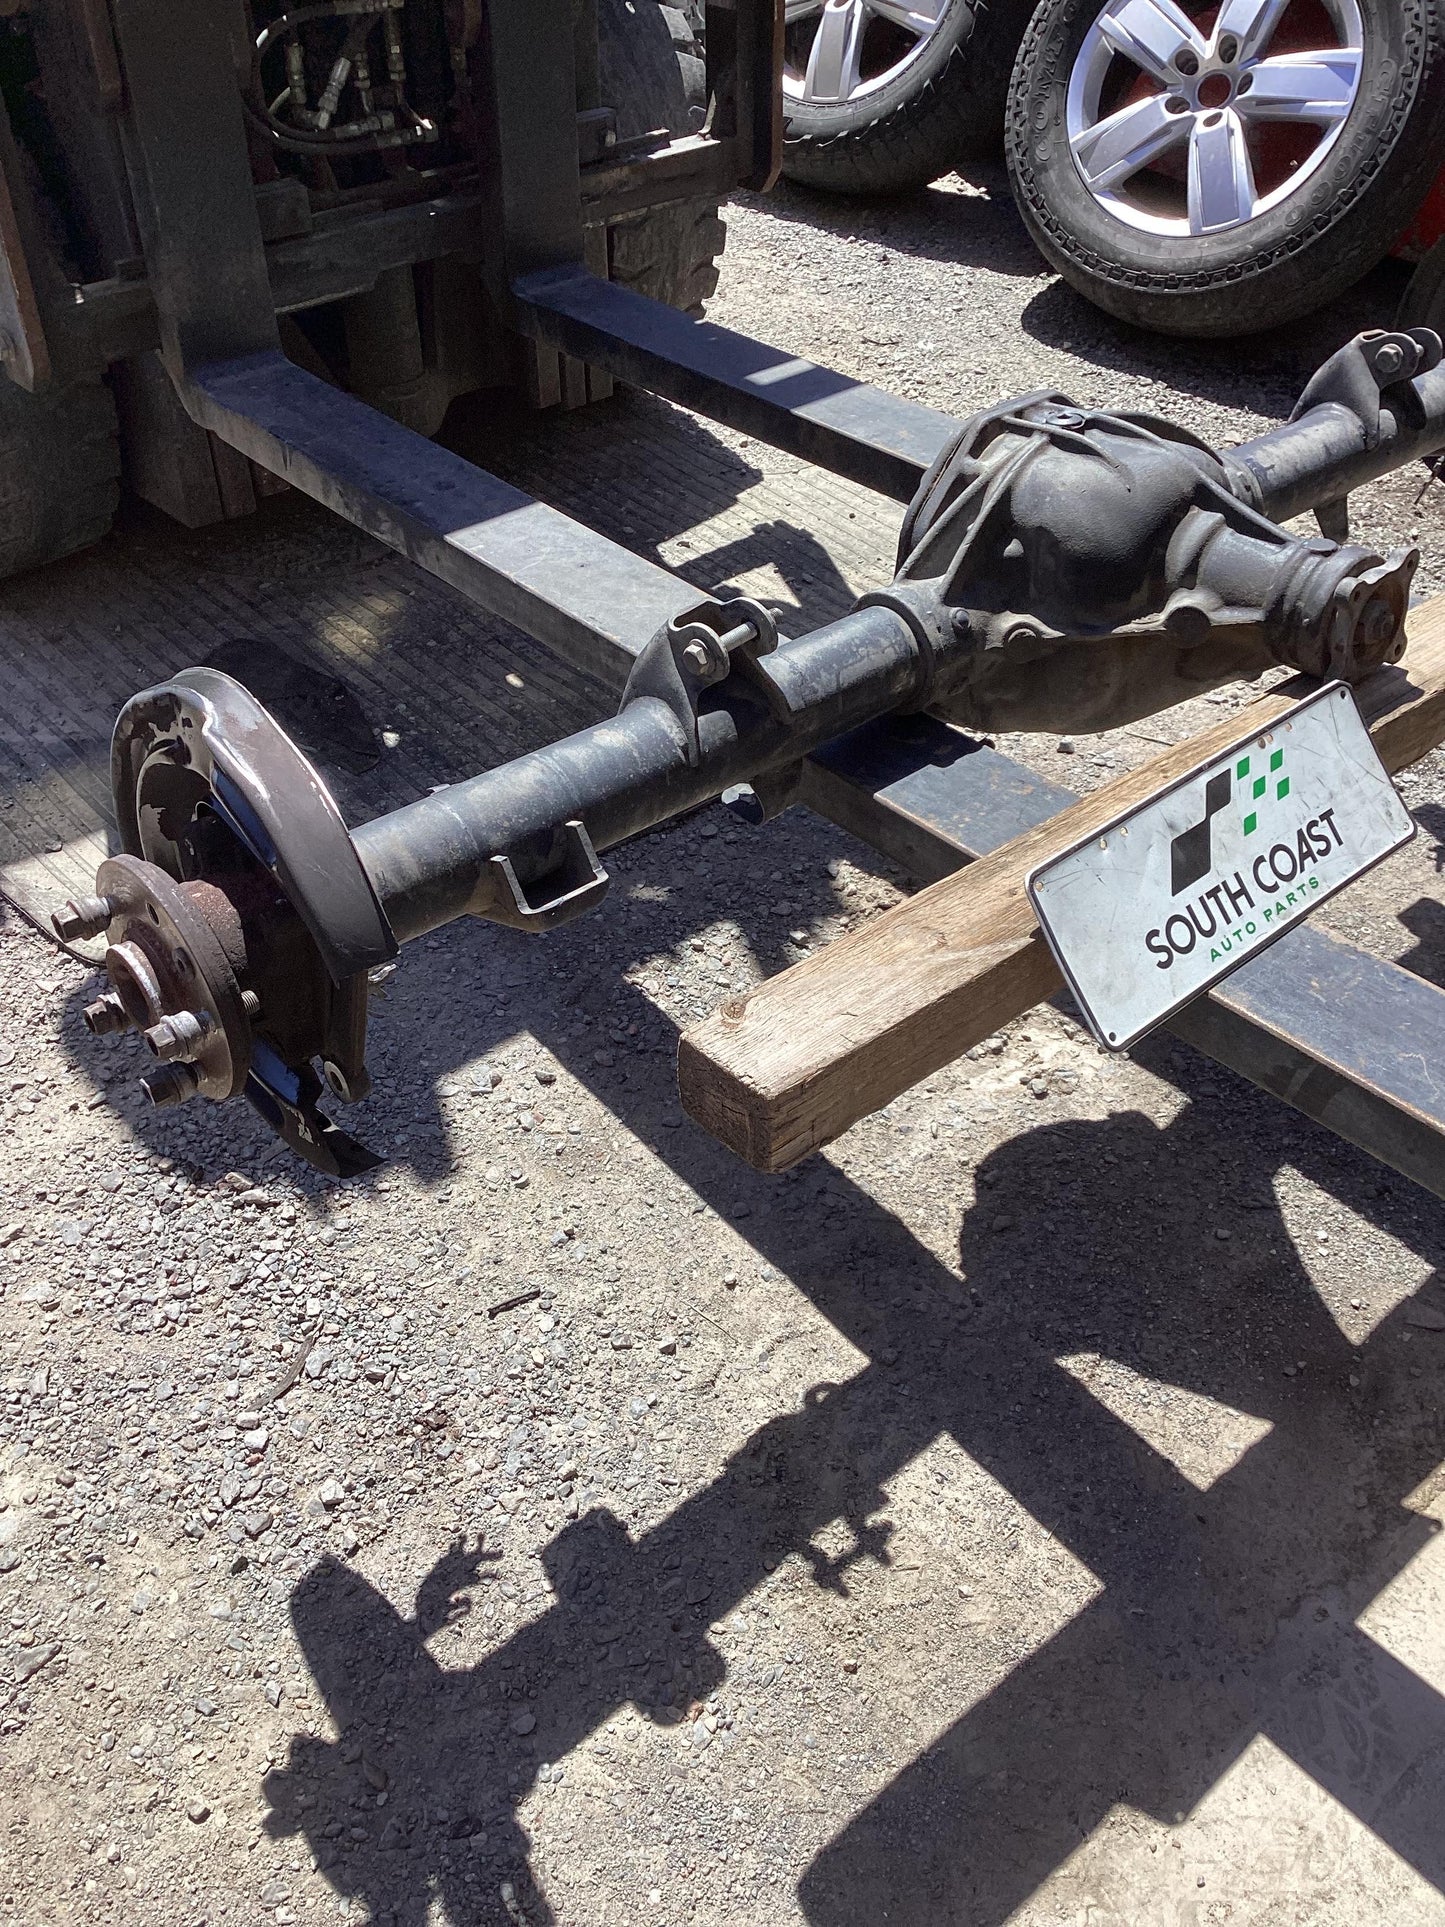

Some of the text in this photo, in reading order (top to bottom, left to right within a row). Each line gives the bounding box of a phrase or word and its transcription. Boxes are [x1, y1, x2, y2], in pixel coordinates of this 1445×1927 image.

[1145, 808, 1344, 970] SOUTH COAST
[1210, 876, 1320, 962] AUTO PARTS
